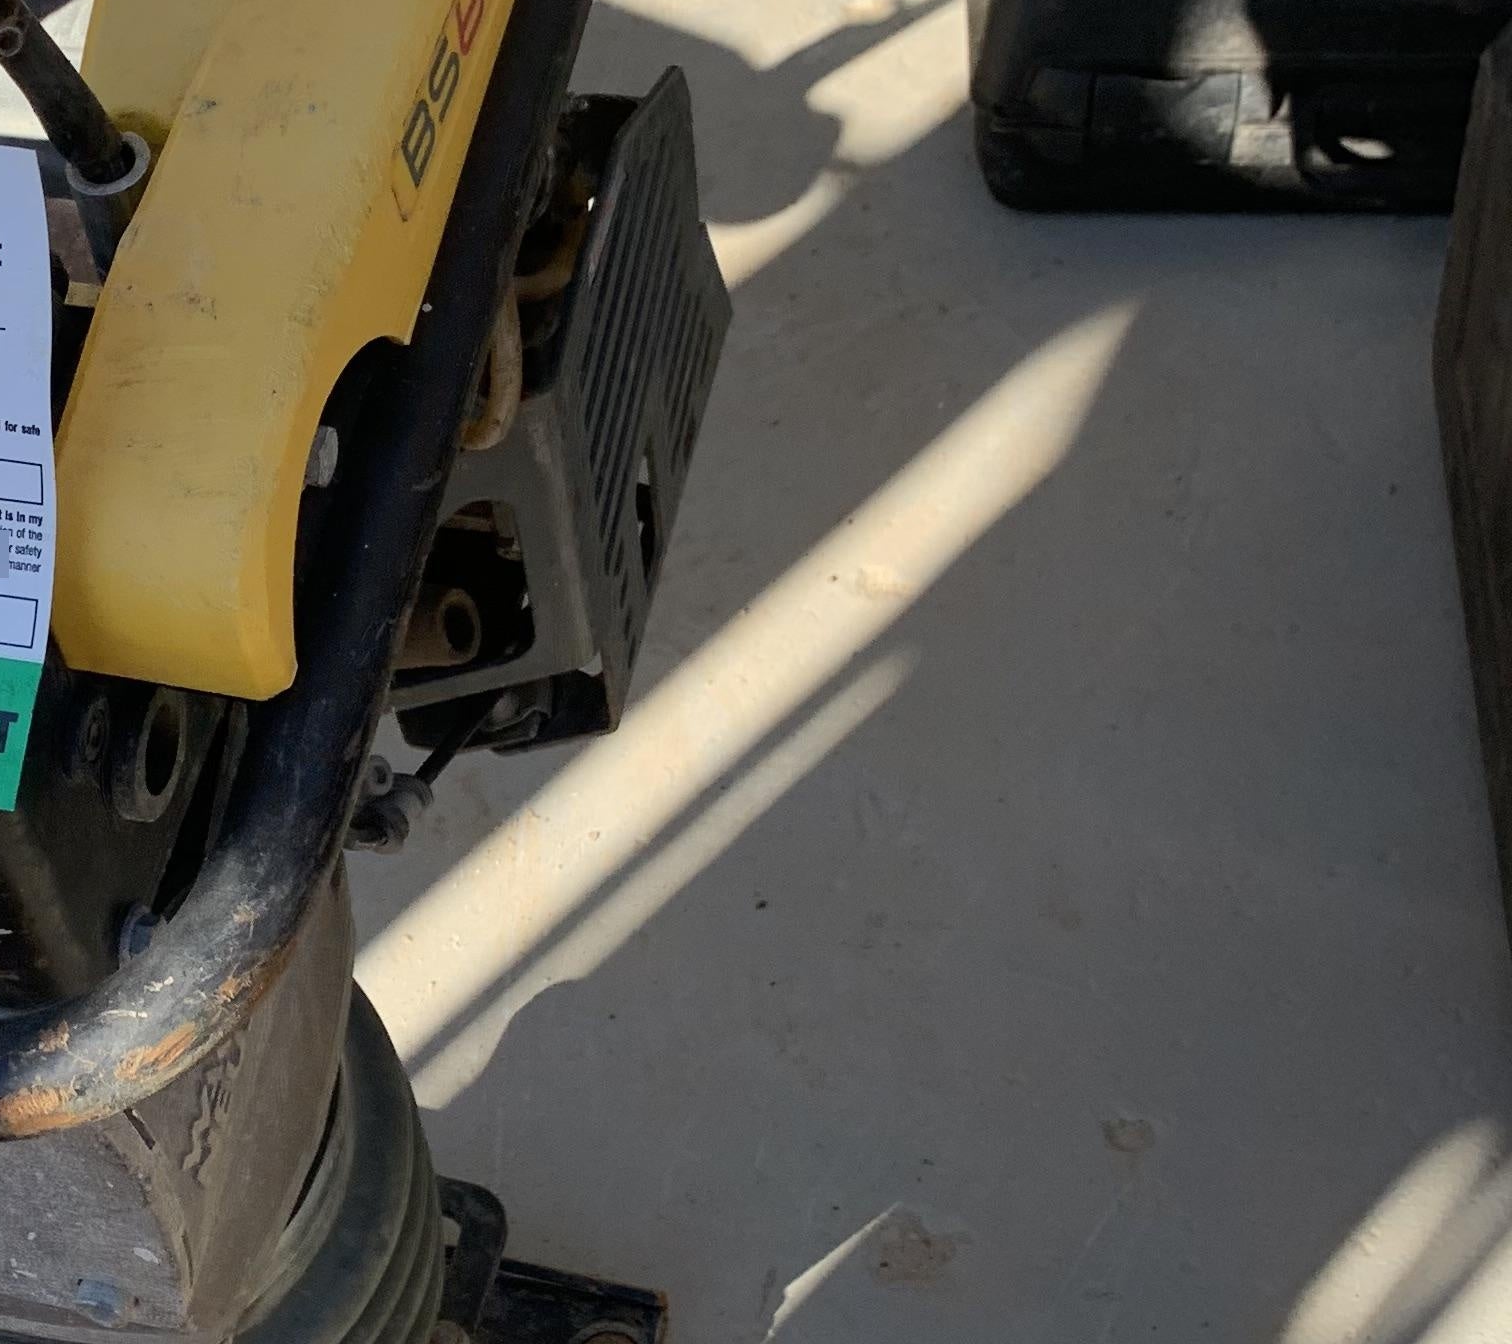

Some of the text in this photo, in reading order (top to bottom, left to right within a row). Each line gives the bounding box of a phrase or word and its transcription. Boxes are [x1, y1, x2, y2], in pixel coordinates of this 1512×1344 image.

[5, 421, 17, 432] for
[22, 425, 40, 436] safe
[5, 510, 13, 521] is
[17, 512, 25, 522] in
[29, 514, 43, 527] my
[17, 528, 25, 537] of
[28, 530, 42, 541] the
[15, 545, 42, 559] safety
